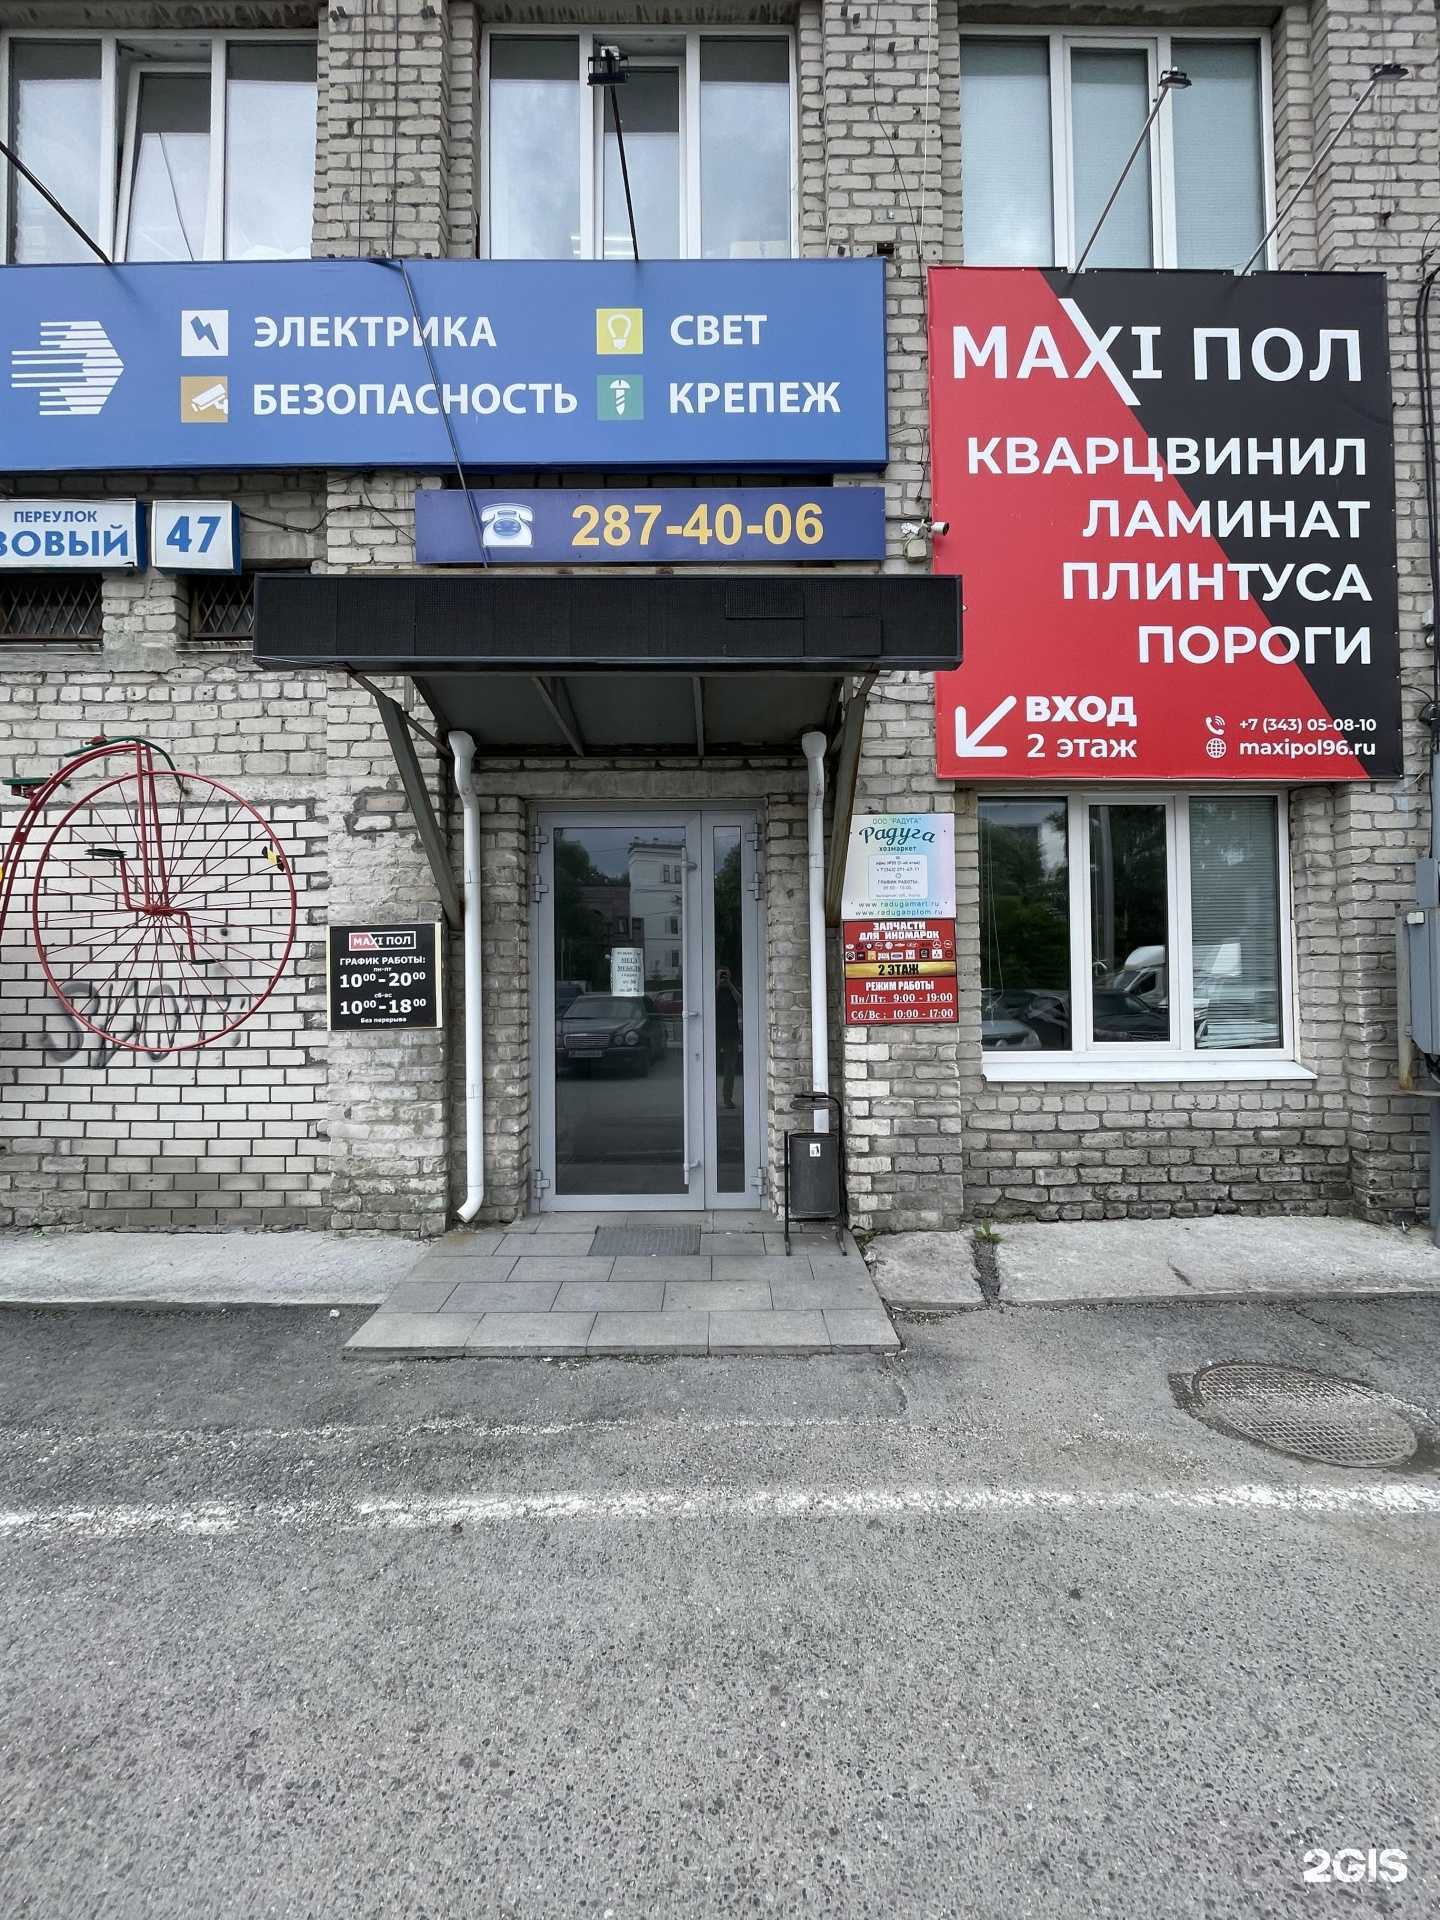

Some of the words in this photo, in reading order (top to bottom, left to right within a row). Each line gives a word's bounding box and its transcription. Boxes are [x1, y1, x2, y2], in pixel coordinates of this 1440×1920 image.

[253, 316, 497, 348] ЭЛЕКТРИКА
[669, 315, 768, 347] СВЕТ
[1193, 327, 1363, 381] ПОЛ
[253, 382, 579, 416] БЕЗОПАСНОСТЬ
[668, 381, 842, 415] КРЕПЕЖ
[968, 437, 1366, 482] КВАРЦВИНИЛ
[13, 510, 98, 523] ПЕРЕУЛОК
[571, 503, 825, 547] 287-40-06
[1082, 500, 1370, 538] ЛАМИНАТ
[166, 515, 221, 553] 47
[1063, 563, 1372, 602] ПЛИНТУСА
[1138, 626, 1371, 665] ПОРОГИ
[1240, 718, 1258, 731] +7
[1263, 718, 1302, 734] (343)
[1307, 718, 1376, 731] 05-08-10
[1027, 733, 1045, 757] 2
[1057, 738, 1137, 758] этаж
[1240, 738, 1376, 758] maxipol96.ru
[859, 826, 936, 846] Радуга
[859, 932, 879, 941] ДЛЯ
[885, 930, 940, 940] ИНОМАРОК
[872, 921, 926, 931] ЗАПЧАСТИ
[386, 936, 411, 946] ПОЛ
[340, 957, 379, 966] ГРАФИК
[382, 956, 426, 965] РАБОТЫ:
[878, 964, 885, 976] 2
[887, 964, 919, 976] ЭТАЖ
[865, 981, 897, 991] РЕЖИМ
[898, 980, 935, 991] РАБОТЫ
[850, 994, 886, 1003] Пн/Пт:
[893, 994, 915, 1003] 9:00
[926, 993, 953, 1002] 19:00
[893, 1010, 918, 1019] 10:00
[929, 1009, 953, 1018] 17:00
